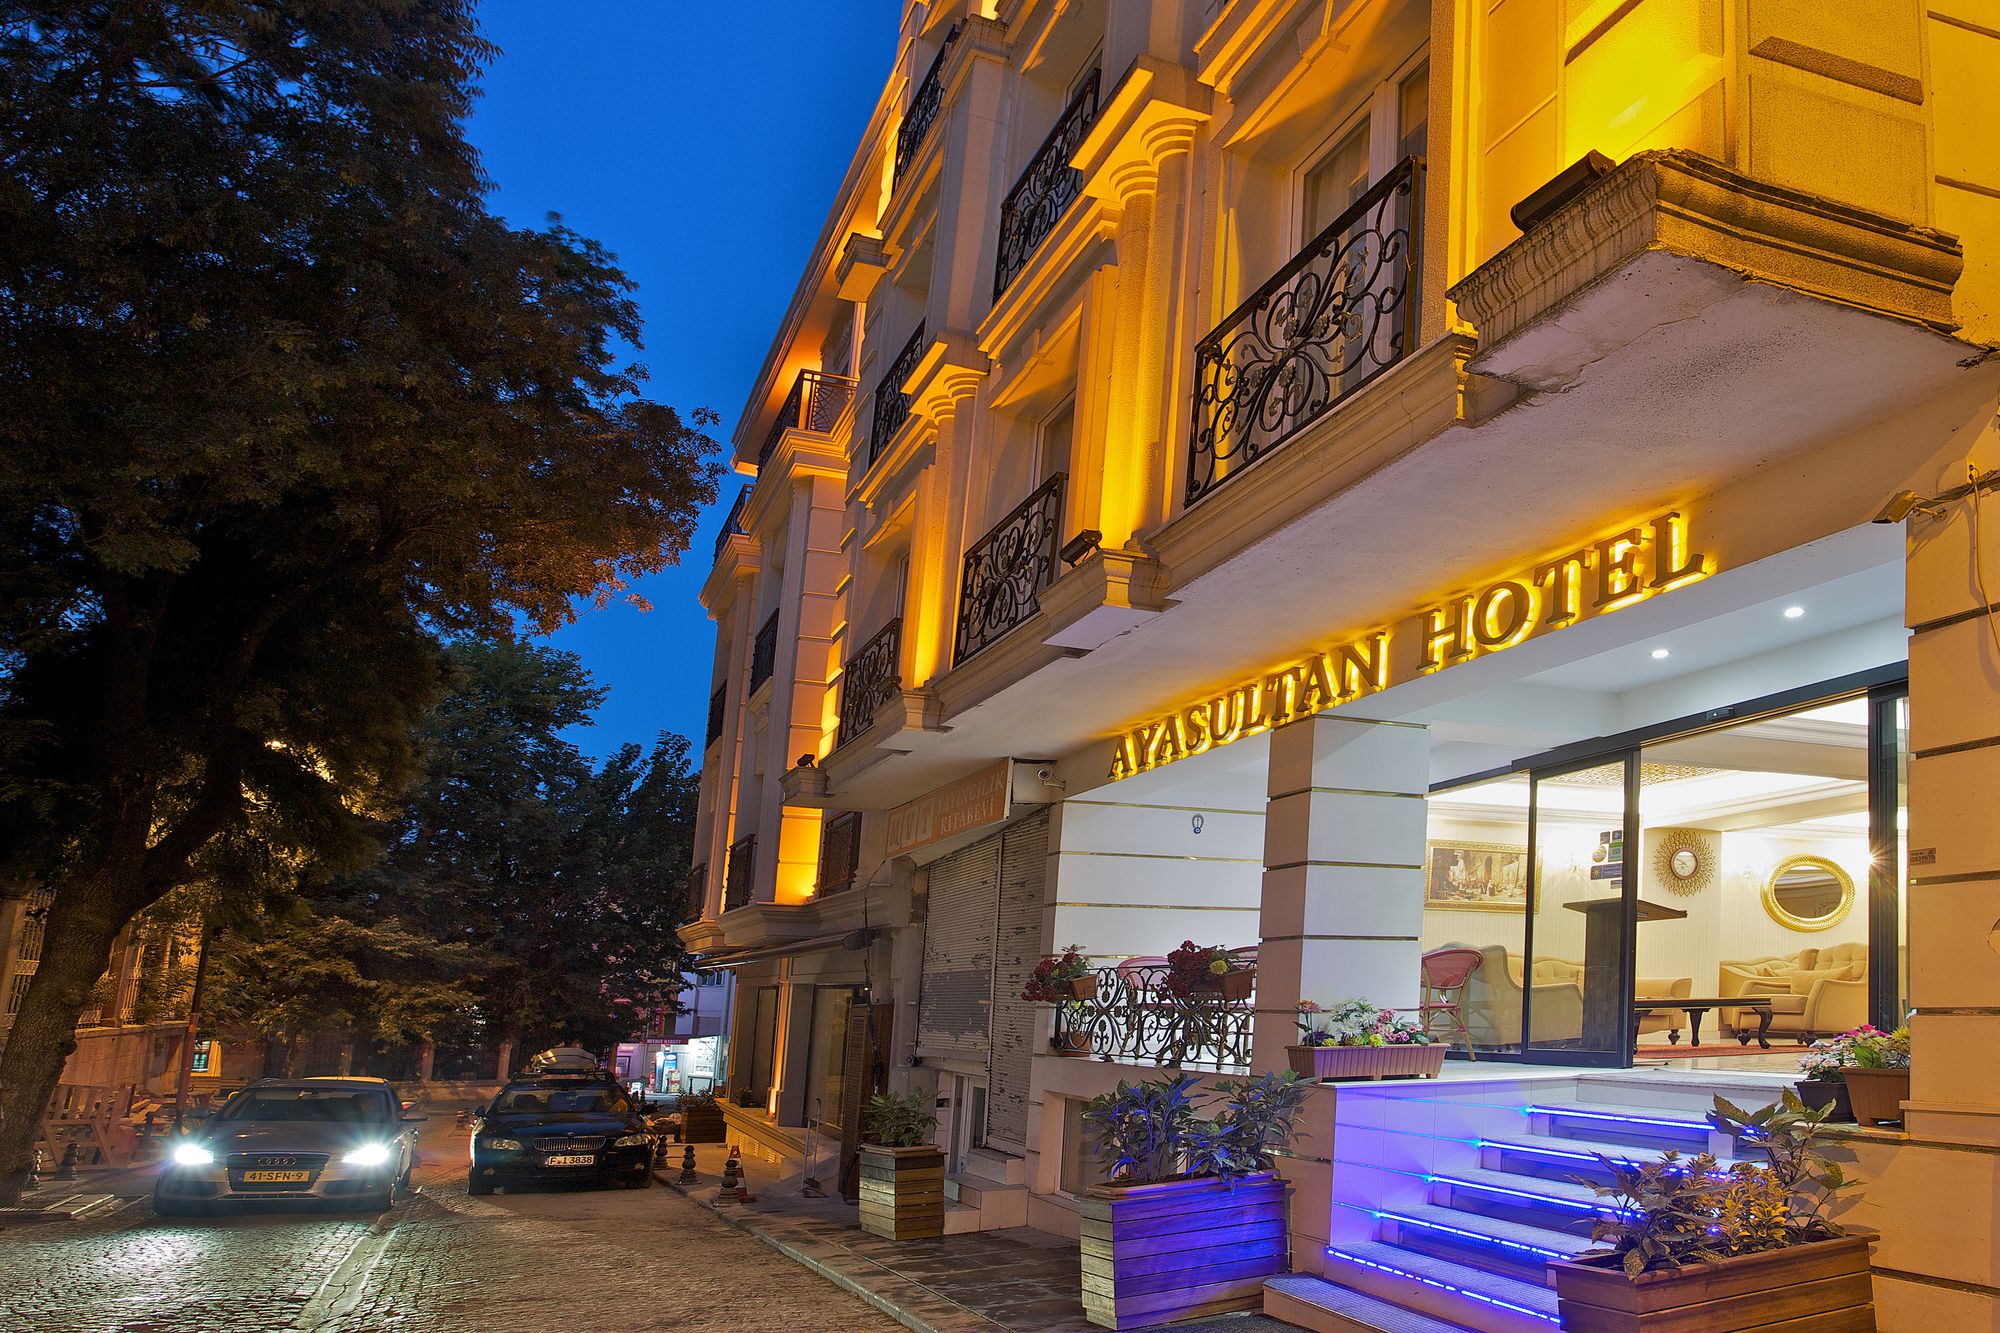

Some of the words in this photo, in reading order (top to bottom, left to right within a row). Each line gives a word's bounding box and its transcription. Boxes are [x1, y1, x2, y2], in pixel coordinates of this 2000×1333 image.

[1106, 631, 1388, 780] AYASULTAN
[1417, 511, 1706, 672] HOTEL
[249, 1172, 304, 1181] 41-SFN-9
